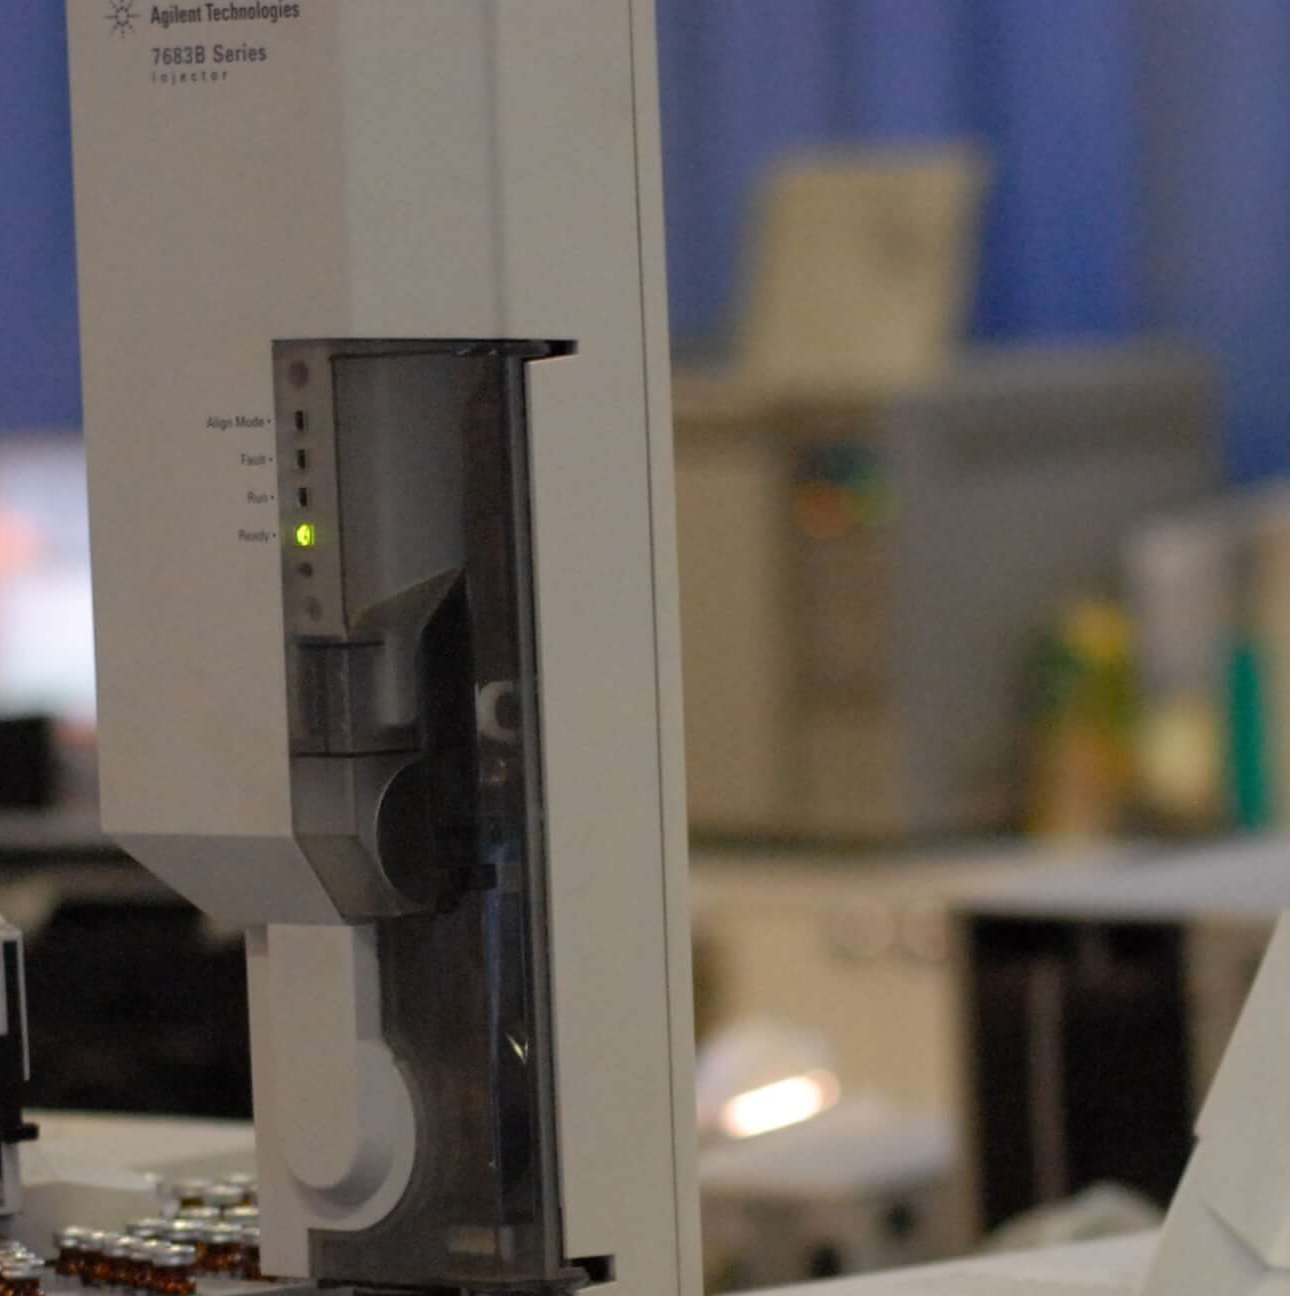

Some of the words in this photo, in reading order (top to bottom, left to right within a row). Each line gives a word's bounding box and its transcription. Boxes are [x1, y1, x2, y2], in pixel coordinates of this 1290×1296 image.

[150, 5, 203, 29] Agilent
[205, 1, 301, 24] Technologies
[151, 46, 206, 65] 7683B
[212, 43, 268, 64] Series
[235, 416, 265, 428] Mode
